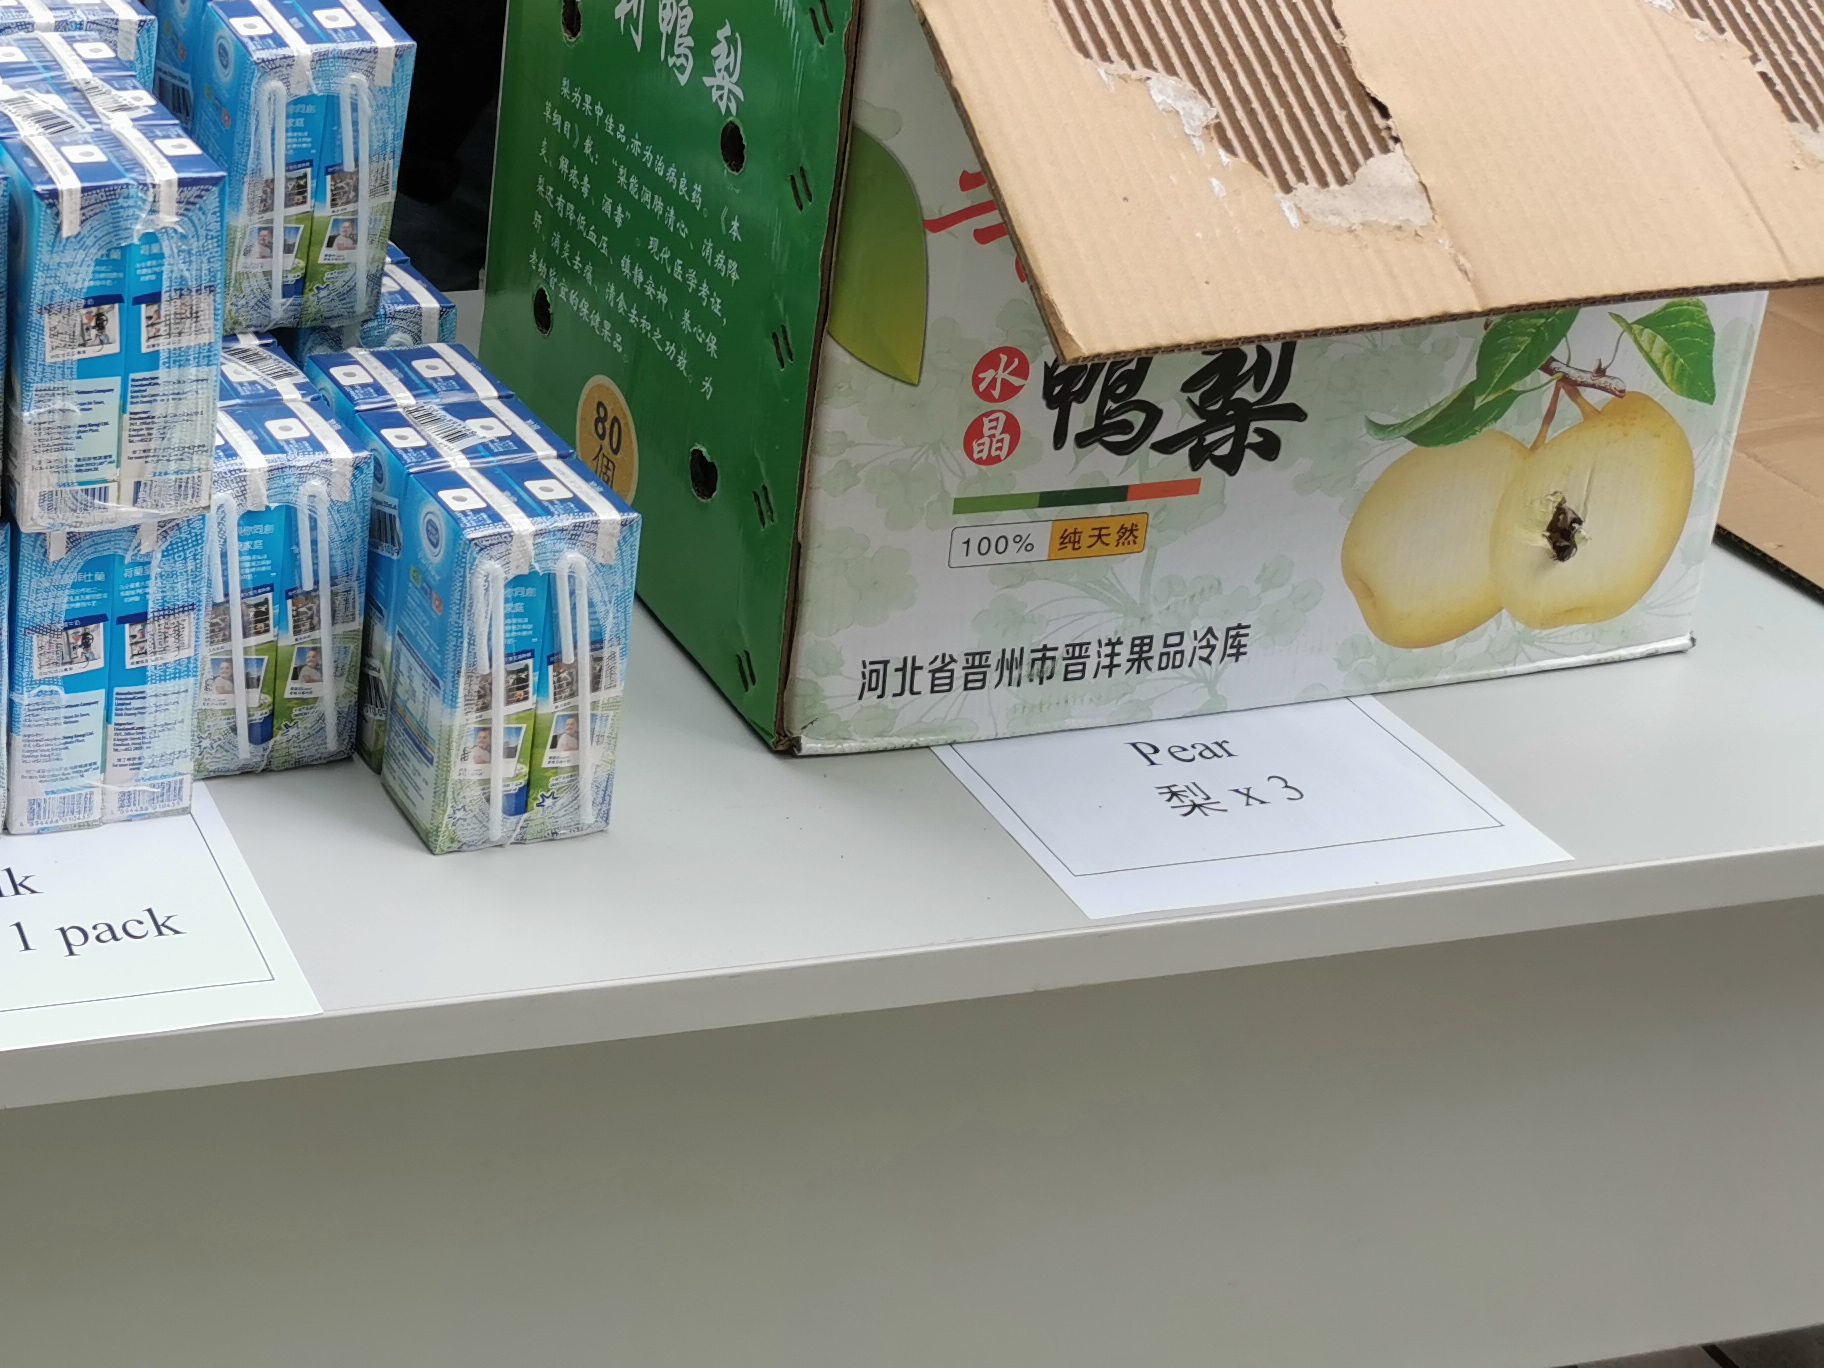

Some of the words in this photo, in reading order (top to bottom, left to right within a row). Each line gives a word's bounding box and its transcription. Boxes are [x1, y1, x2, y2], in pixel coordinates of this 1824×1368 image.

[594, 401, 622, 455] 80
[972, 353, 1027, 460] 水晶
[960, 532, 1036, 557] 100%
[1057, 523, 1141, 552] 纯天然
[858, 623, 1252, 701] 河北省晋州市晋洋果品冷库
[1124, 736, 1238, 767] Pear
[1156, 781, 1228, 817] 梨
[1228, 786, 1272, 807] x
[1266, 775, 1306, 806] 3
[10, 921, 36, 953] 1
[55, 907, 189, 957] pack
